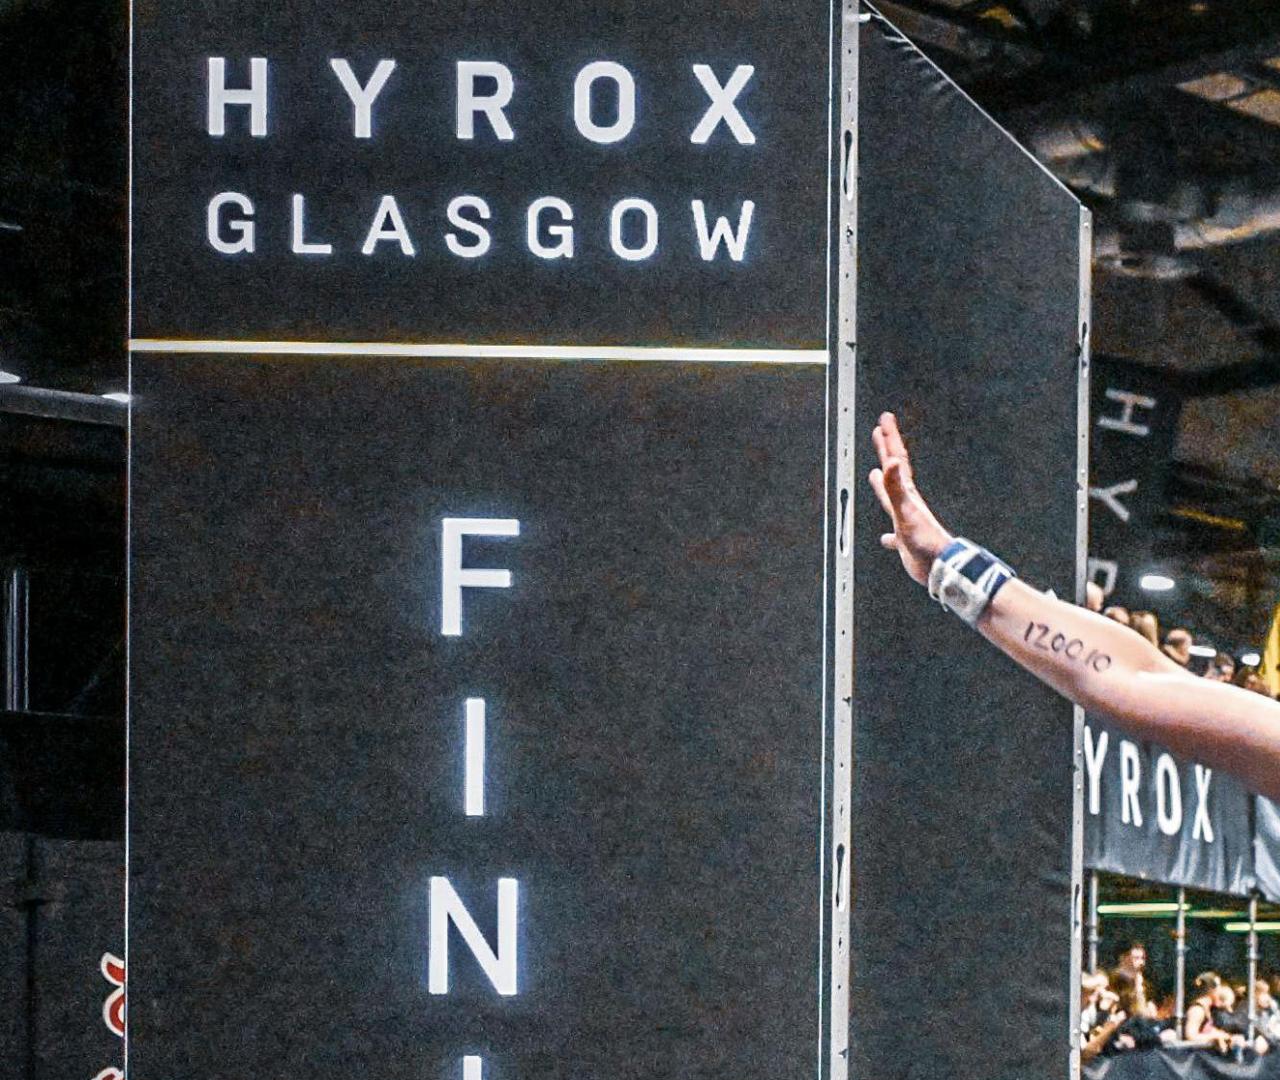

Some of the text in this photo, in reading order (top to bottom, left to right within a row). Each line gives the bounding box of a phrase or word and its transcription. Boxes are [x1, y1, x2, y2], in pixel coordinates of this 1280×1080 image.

[207, 57, 756, 144] HYROX
[207, 192, 756, 261] GLASGOW
[1084, 725, 1214, 843] YROX
